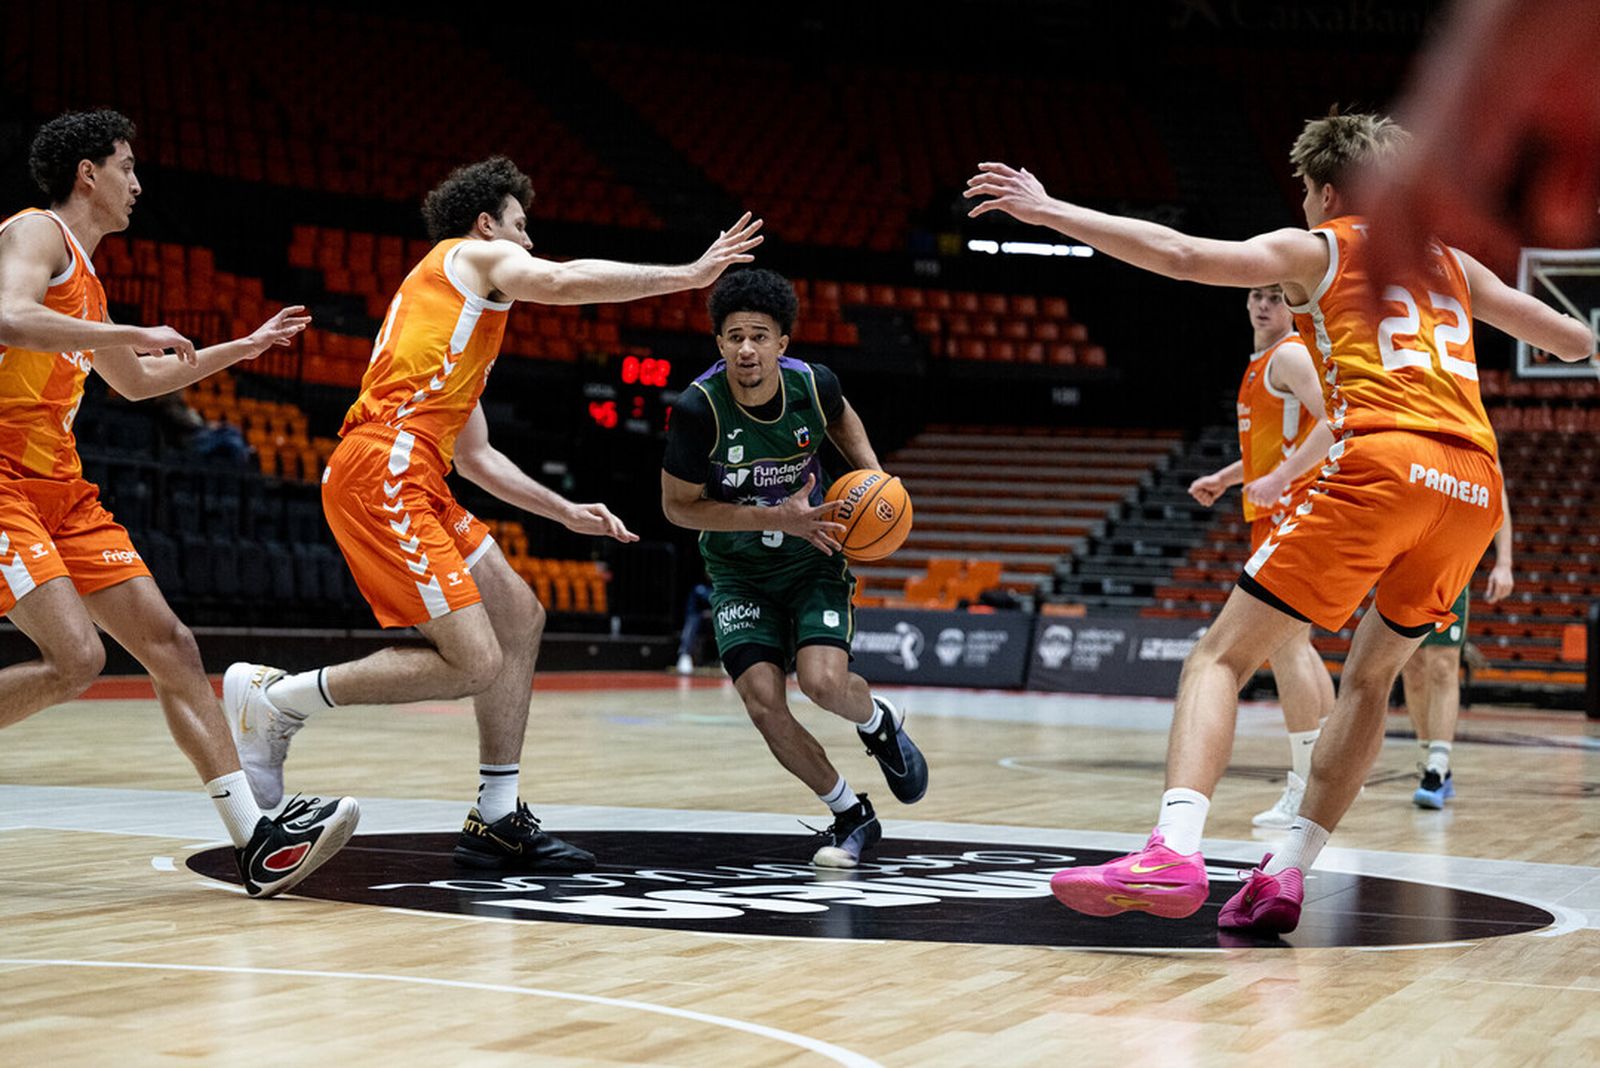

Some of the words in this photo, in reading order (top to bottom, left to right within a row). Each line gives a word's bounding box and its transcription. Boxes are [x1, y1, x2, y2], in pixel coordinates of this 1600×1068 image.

[1377, 285, 1479, 381] 22
[838, 474, 881, 519] Wilson
[1409, 463, 1489, 509] PAMESA
